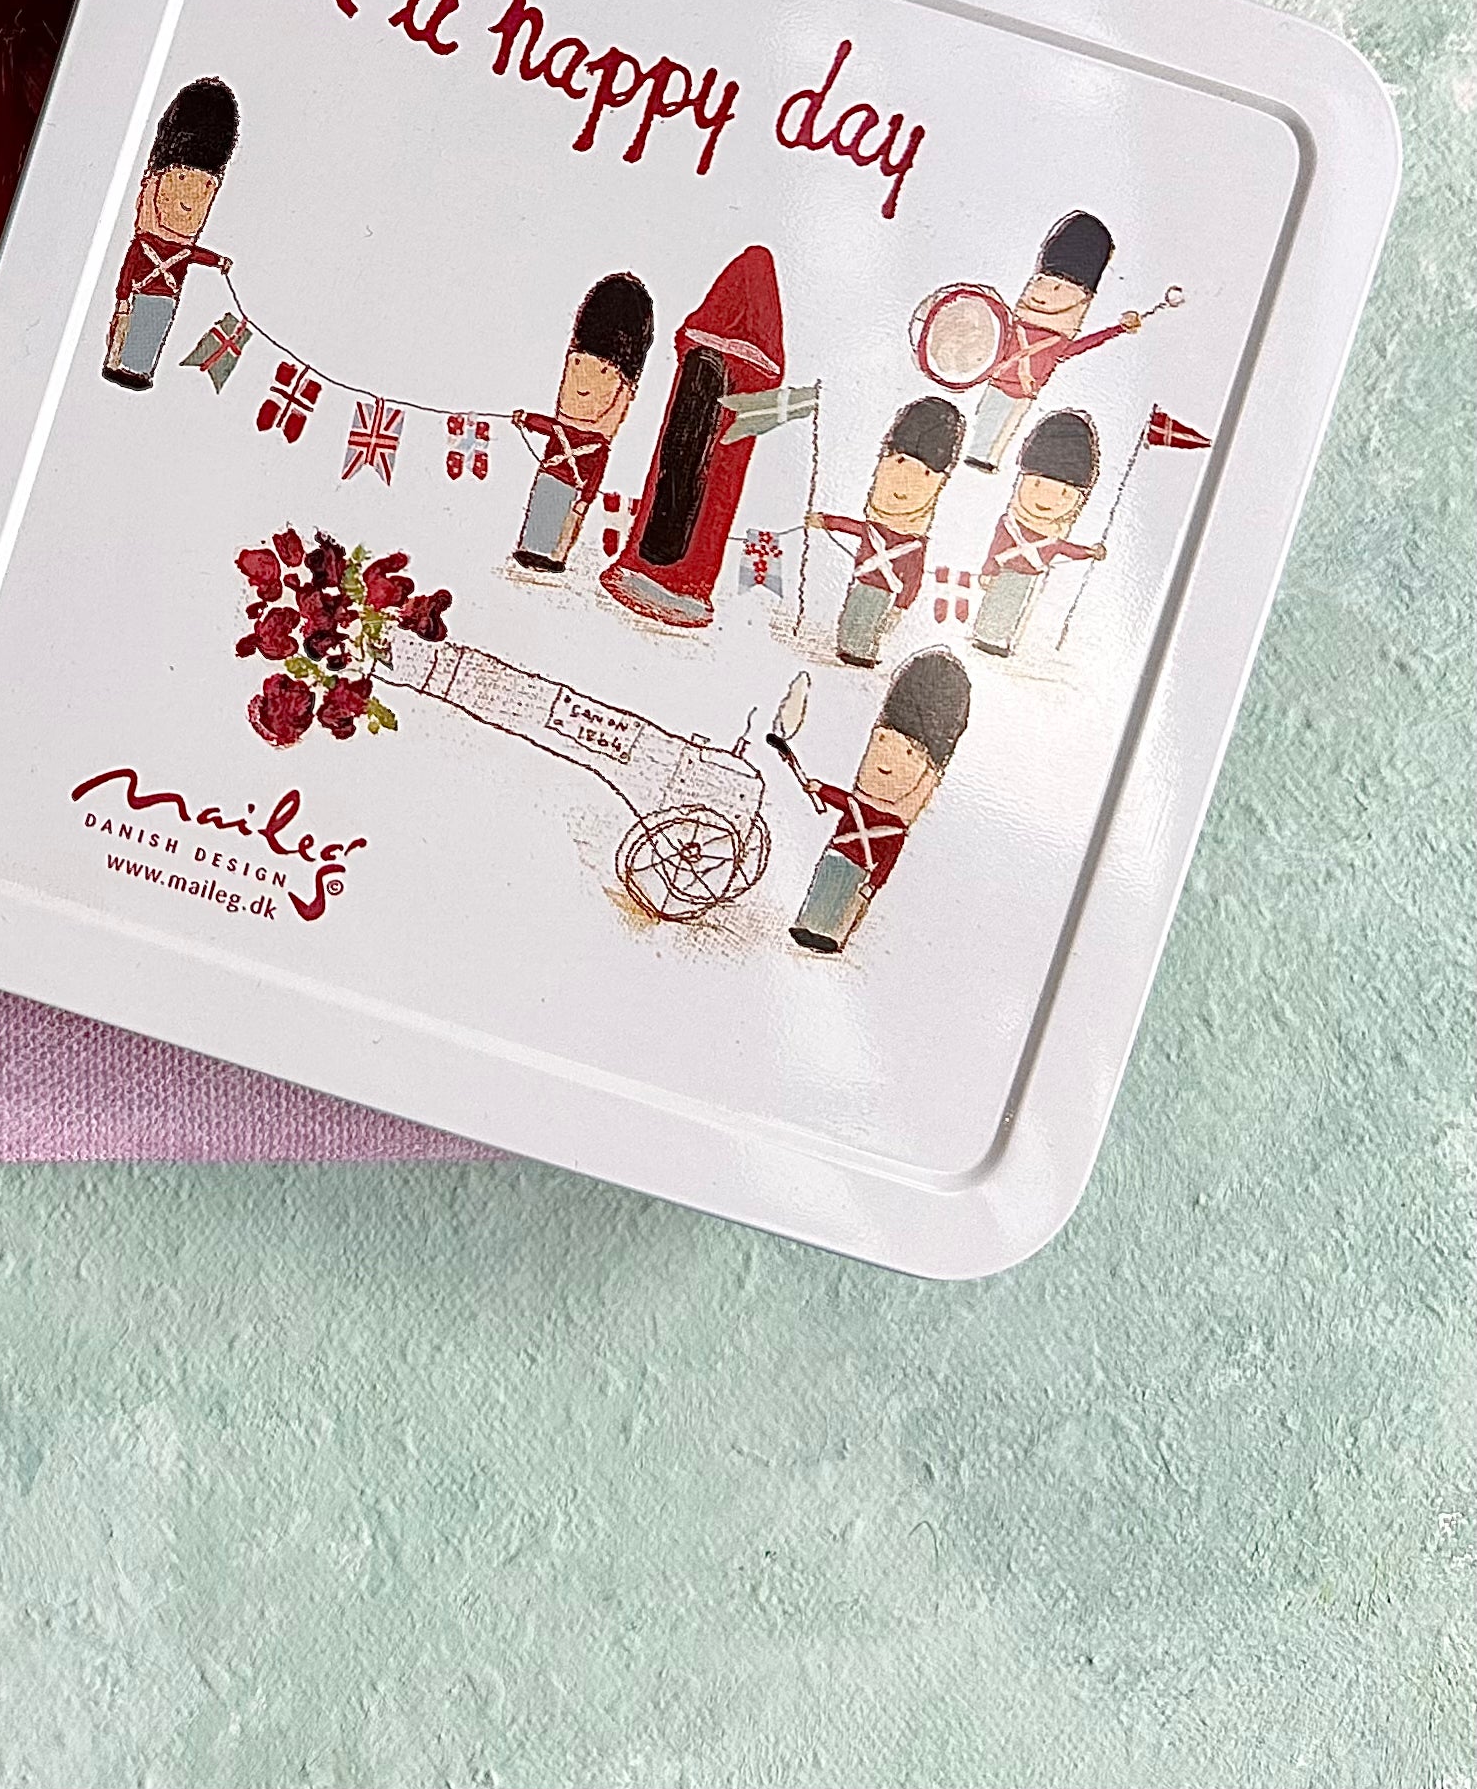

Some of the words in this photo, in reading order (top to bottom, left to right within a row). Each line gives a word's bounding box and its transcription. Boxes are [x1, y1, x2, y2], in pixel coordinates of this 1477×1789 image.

[775, 40, 926, 219] day
[84, 812, 179, 854] DANISH
[194, 846, 287, 889] DESIGN
[106, 853, 277, 920] www.maileg.dk
